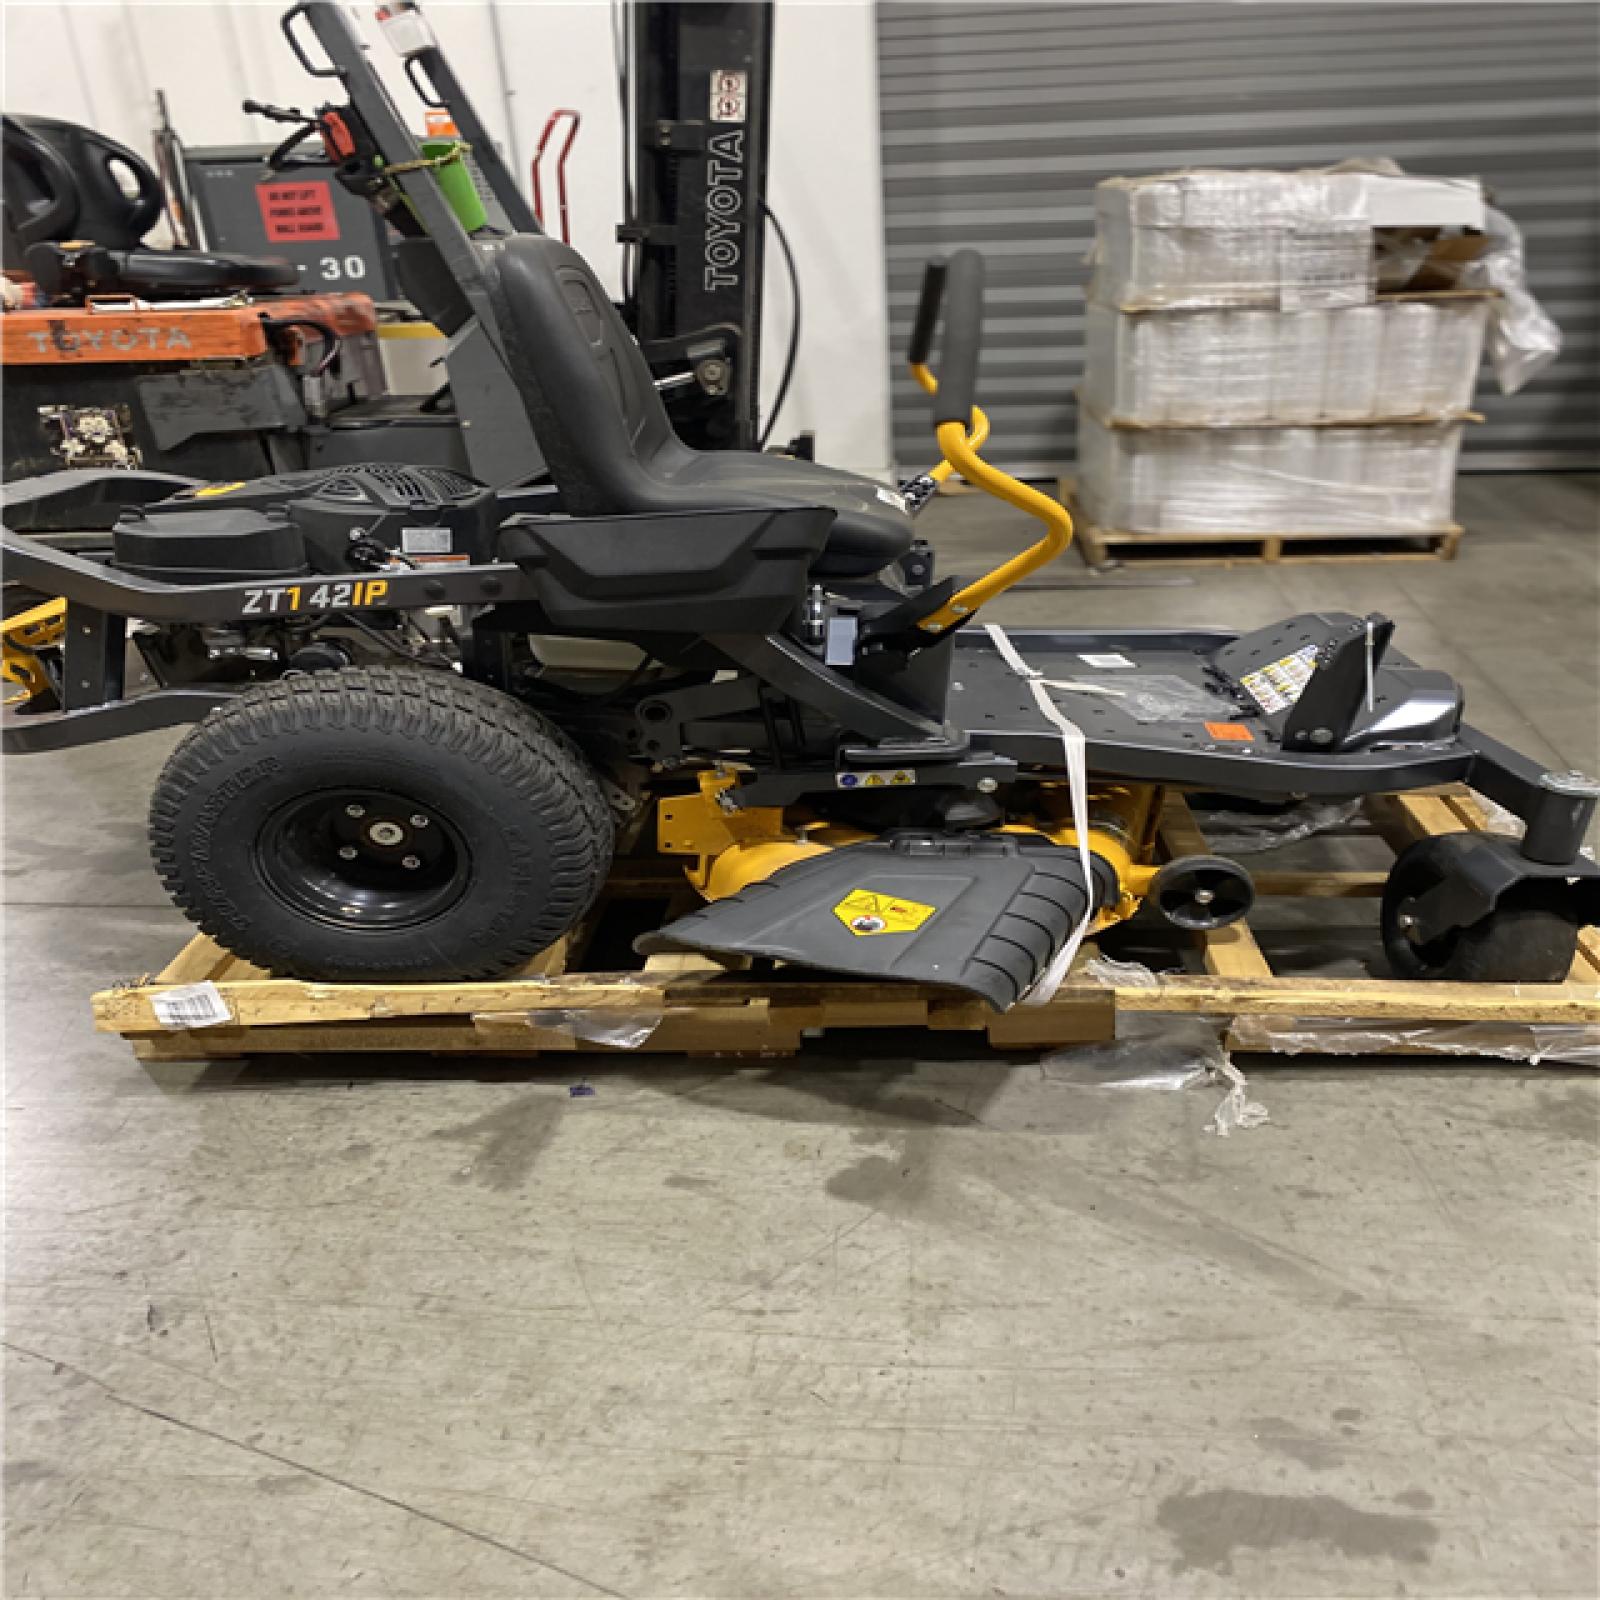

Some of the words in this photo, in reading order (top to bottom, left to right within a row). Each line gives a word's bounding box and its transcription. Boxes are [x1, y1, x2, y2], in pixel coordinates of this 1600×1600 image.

[705, 129, 744, 291] TOYOTA
[320, 255, 366, 280] 30
[28, 327, 192, 353] TOYOTA
[242, 586, 300, 614] ZT1
[309, 580, 388, 608] 42IP
